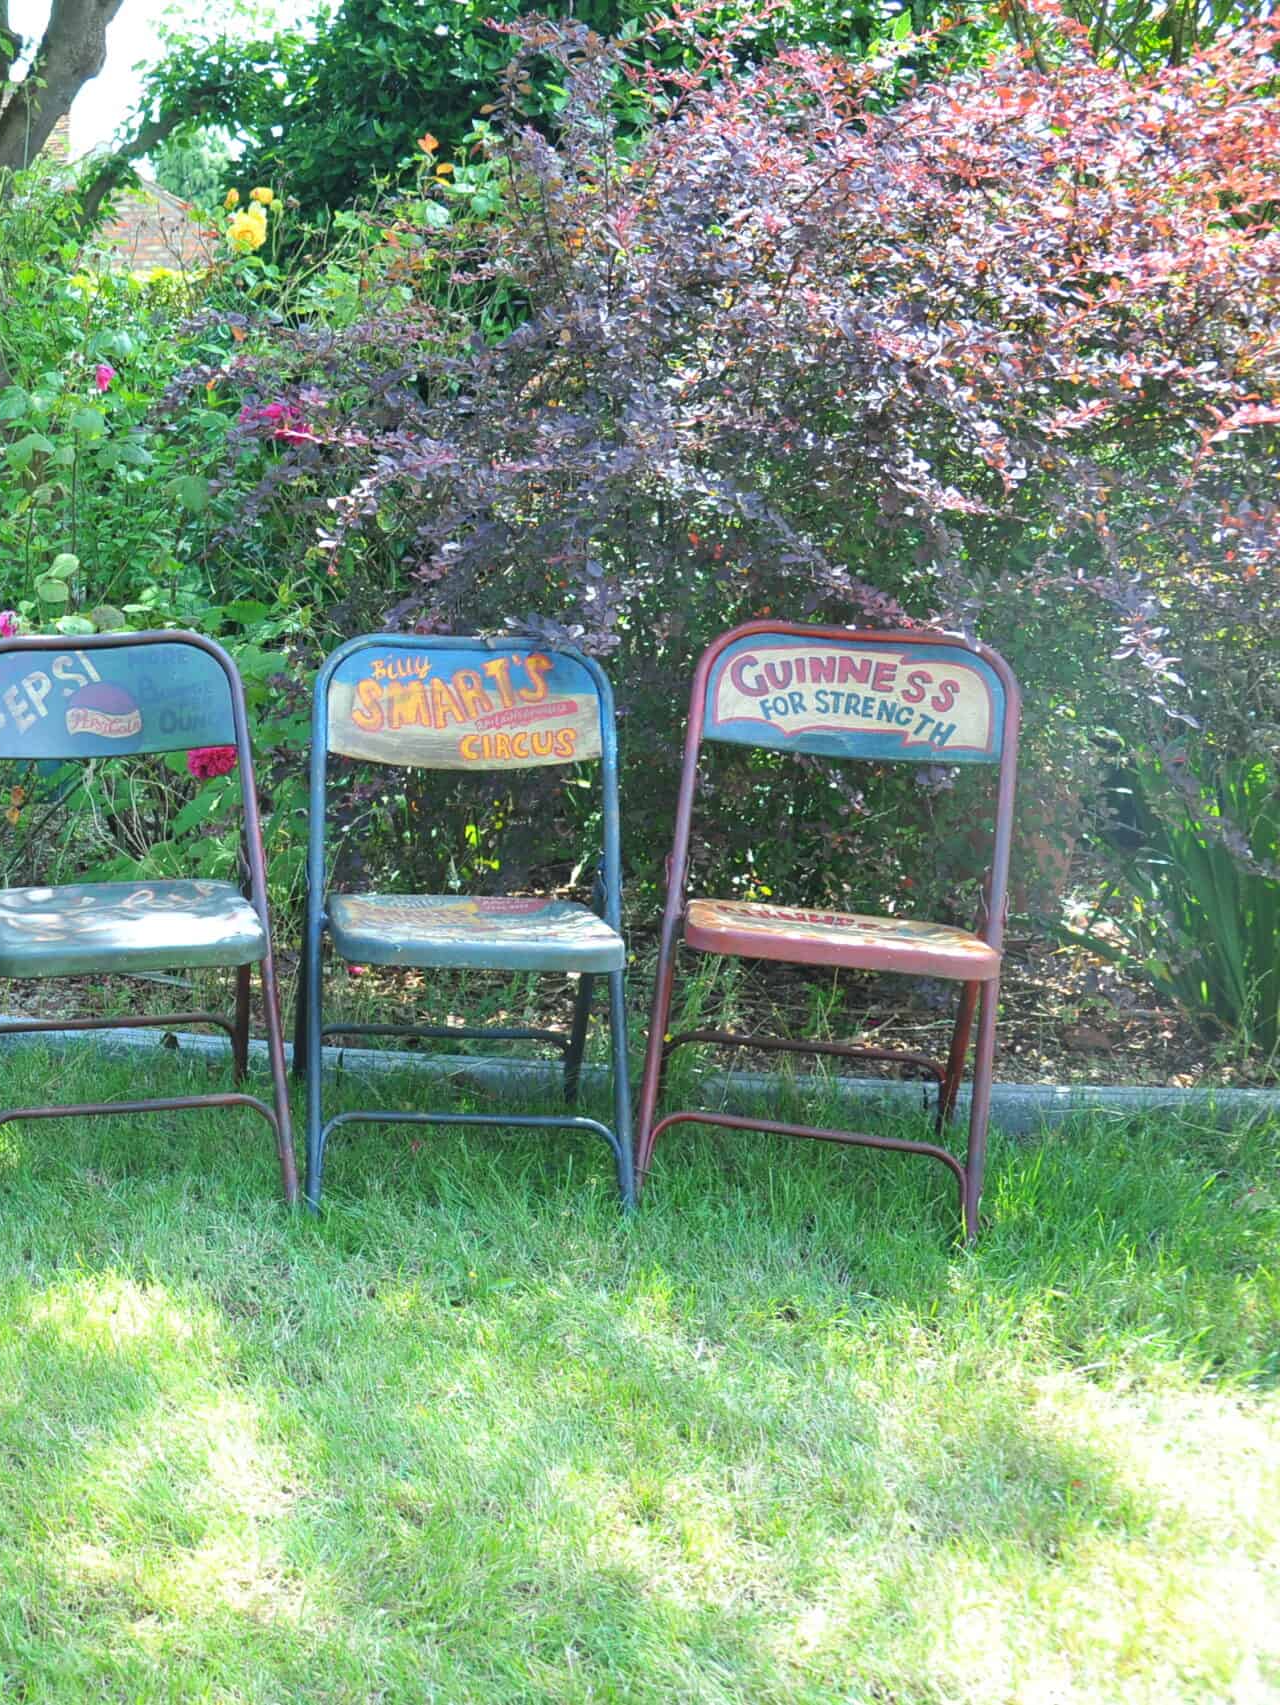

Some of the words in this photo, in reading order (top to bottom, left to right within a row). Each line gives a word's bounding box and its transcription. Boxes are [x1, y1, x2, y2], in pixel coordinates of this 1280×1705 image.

[352, 653, 554, 732] SMART'S
[730, 655, 960, 712] GUINNESS
[759, 691, 807, 720] FOR
[459, 727, 577, 761] CIRCUS
